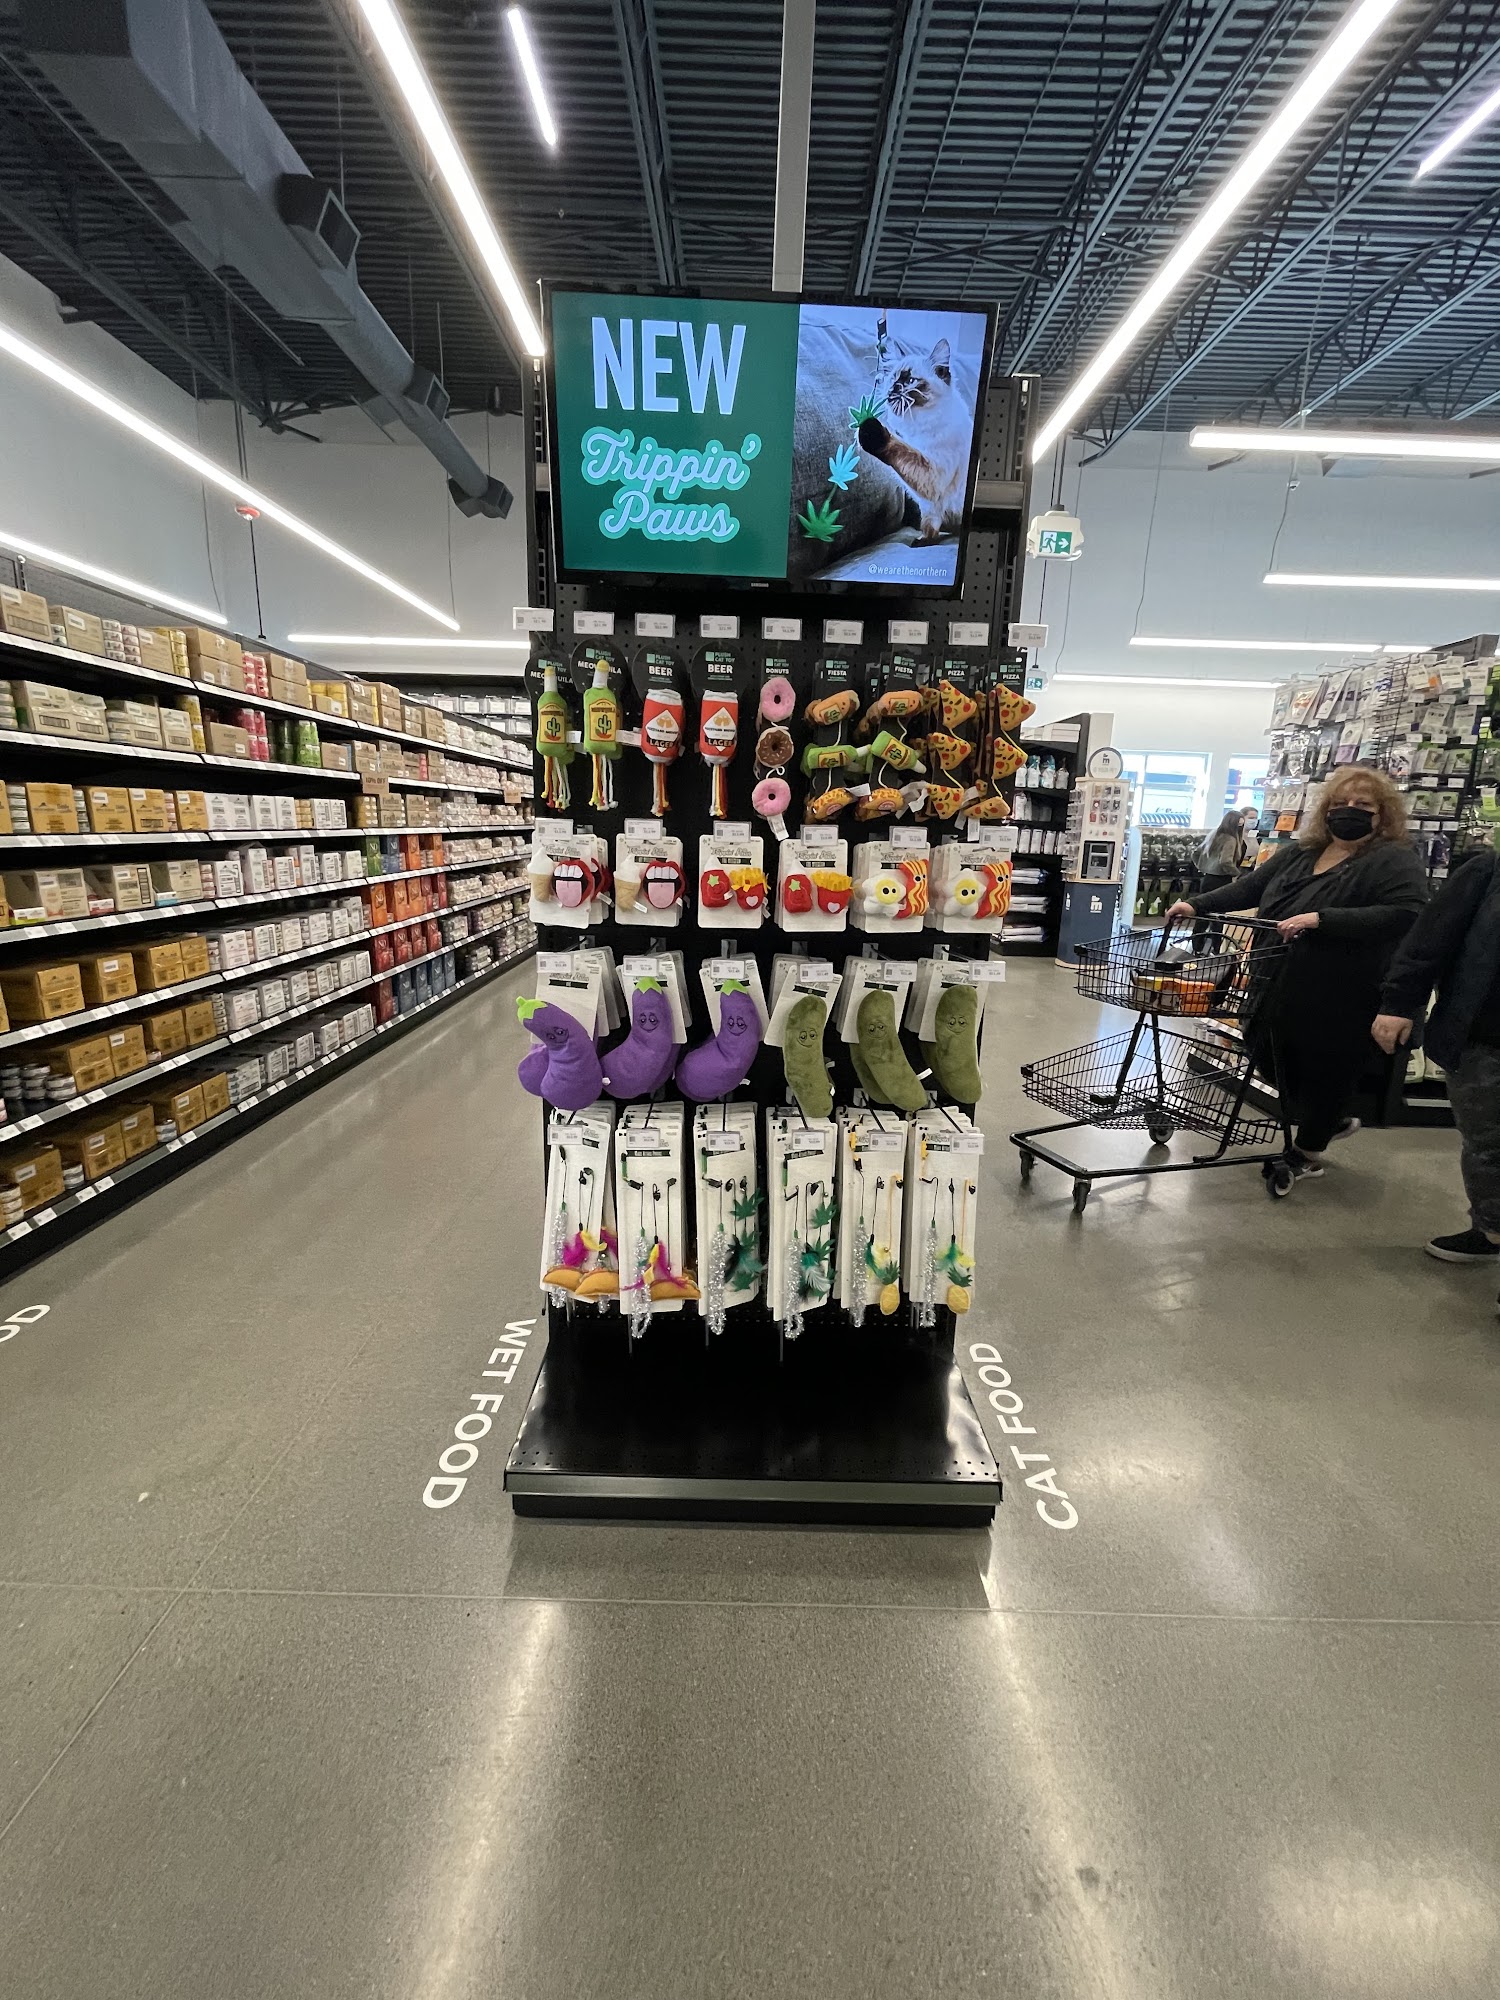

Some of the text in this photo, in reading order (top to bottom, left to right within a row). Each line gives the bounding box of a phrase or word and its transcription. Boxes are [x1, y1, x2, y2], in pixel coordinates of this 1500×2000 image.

[591, 316, 747, 415] NEW
[584, 430, 759, 496] Trippin'
[602, 488, 737, 540] Paws
[868, 563, 948, 578] @wearethenorthern
[648, 665, 673, 677] BEER
[707, 663, 733, 674] BEER
[894, 665, 913, 675] FIESTA
[649, 739, 674, 748] LAGER
[708, 739, 733, 747] LAGER
[422, 1318, 538, 1509] WET FOOD
[969, 1342, 1079, 1530] CAT FOOD
